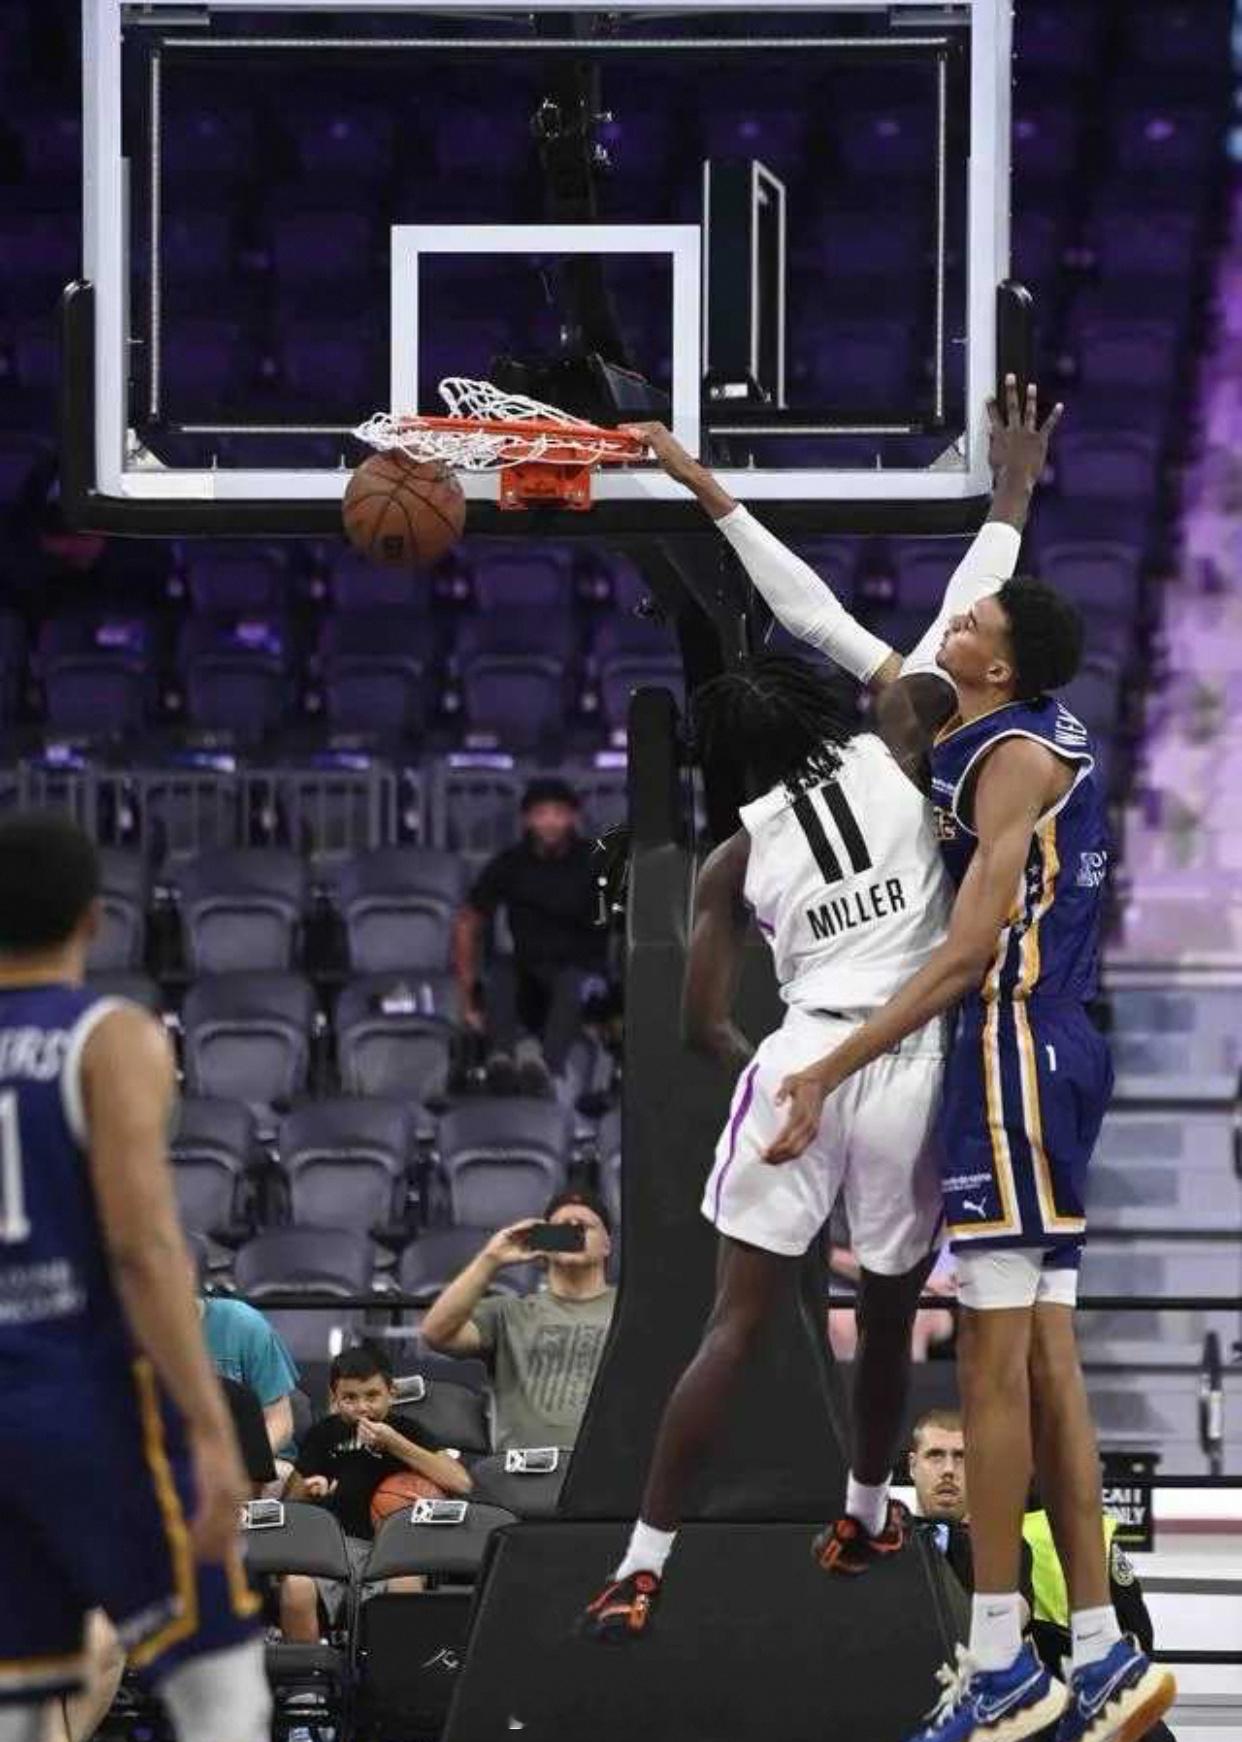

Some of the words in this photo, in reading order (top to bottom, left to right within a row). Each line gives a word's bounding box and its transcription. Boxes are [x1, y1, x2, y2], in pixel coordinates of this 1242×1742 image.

[791, 781, 873, 885] 11
[806, 878, 906, 941] MILLER
[1045, 1045, 1056, 1072] 1
